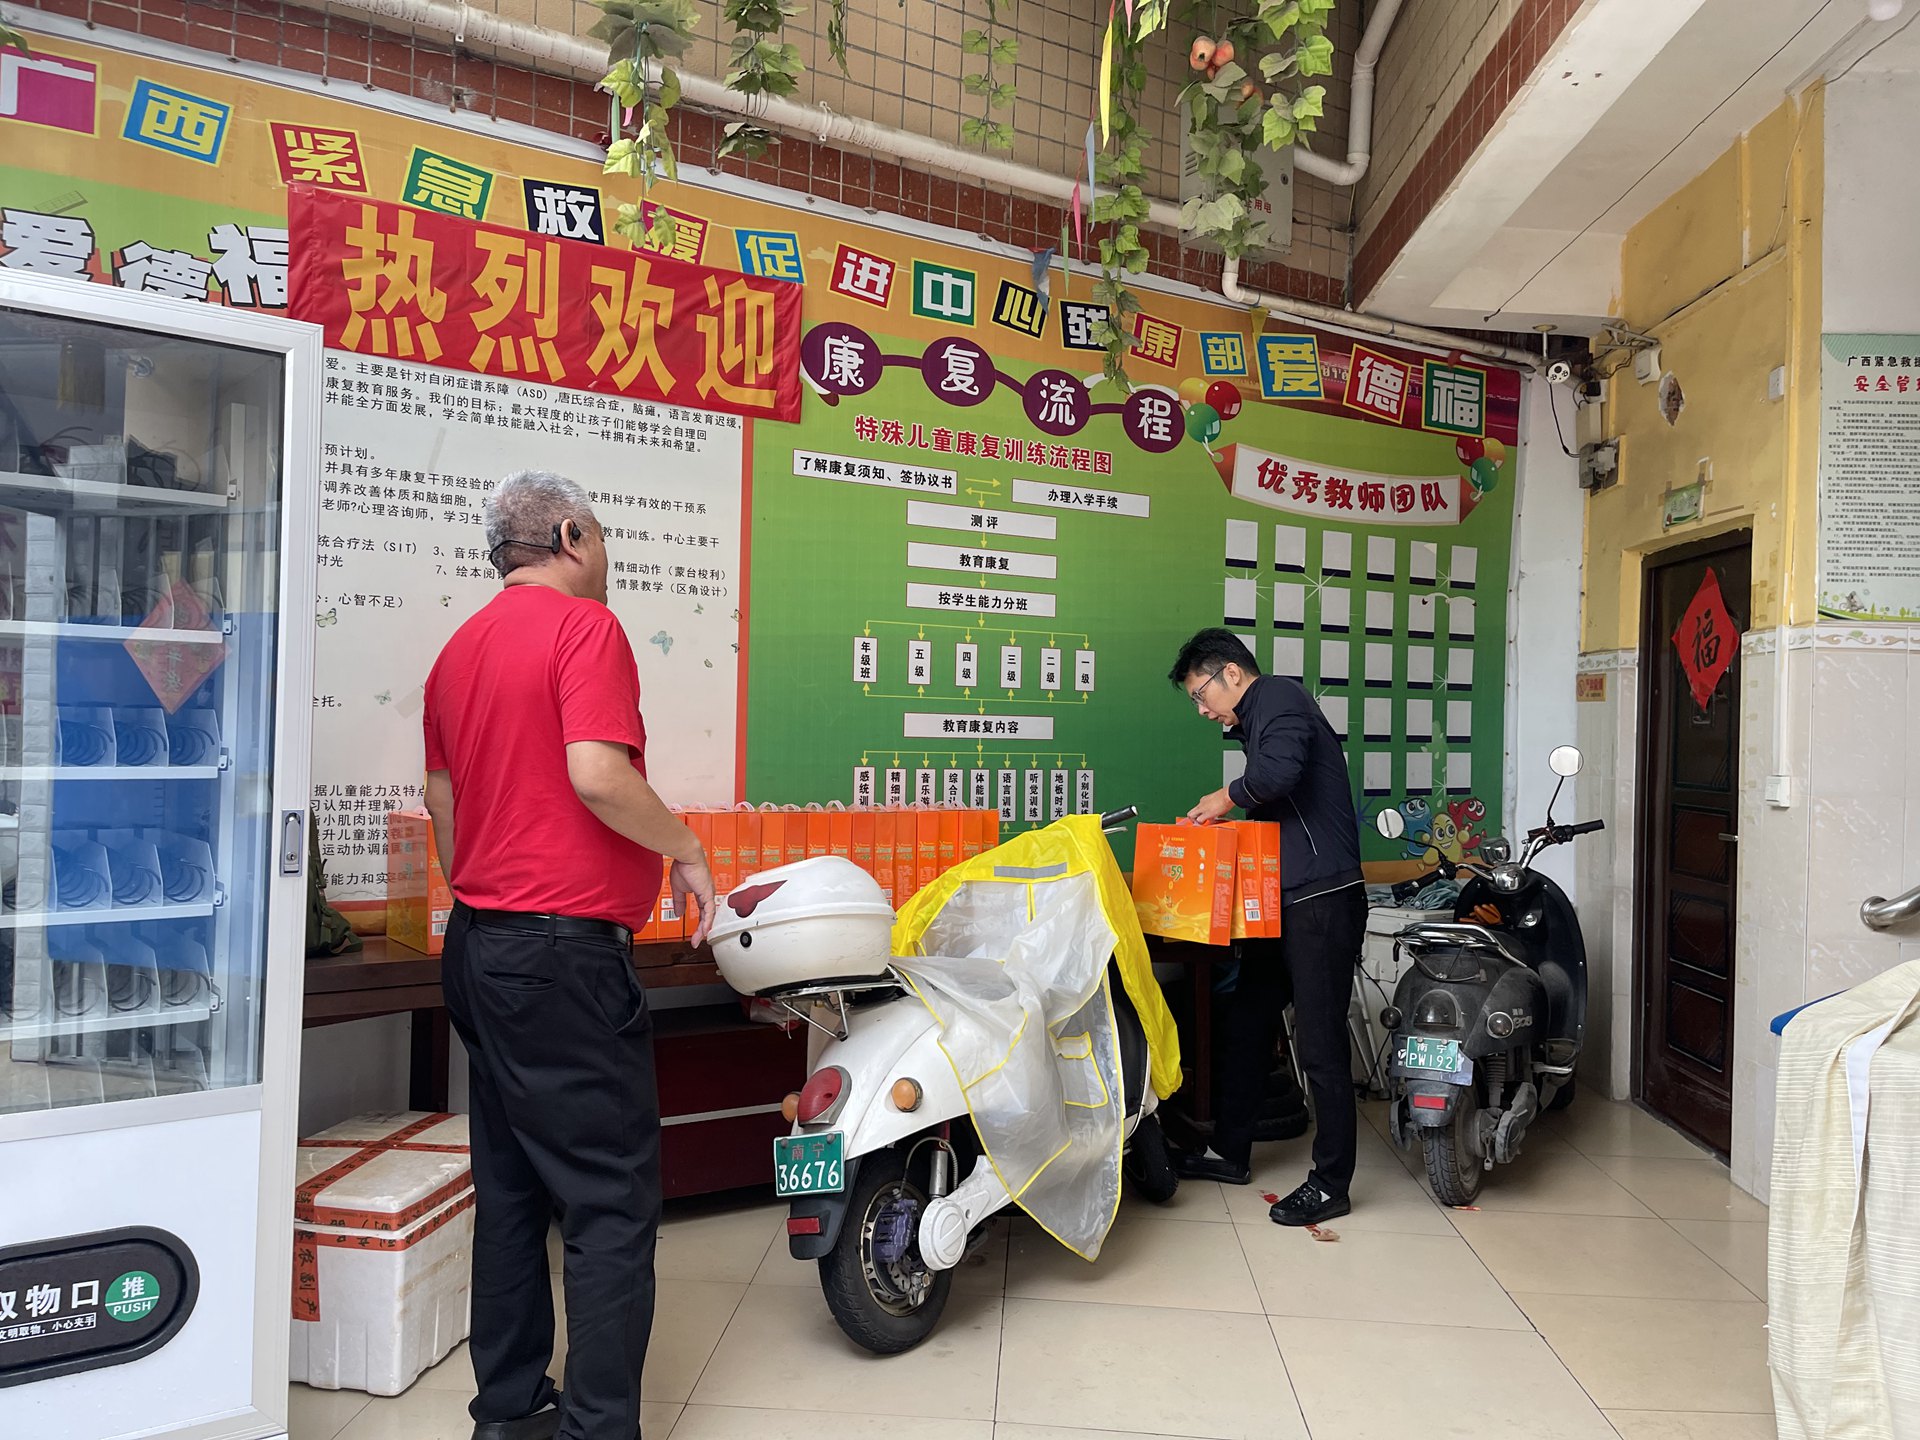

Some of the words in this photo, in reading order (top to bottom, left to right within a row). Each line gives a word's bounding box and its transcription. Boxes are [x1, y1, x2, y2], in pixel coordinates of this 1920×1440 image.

[341, 205, 776, 408] 热烈欢迎
[821, 334, 1172, 442] 康复流程
[1854, 375, 1920, 393] 安全管
[855, 415, 1113, 474] 特殊儿童康复训练流程图
[800, 456, 952, 489] 了解康复须知、签协议书
[1257, 458, 1449, 513] 优秀教师团队
[320, 480, 487, 508] 调养改善体质和脑细胞，
[1048, 489, 1118, 509] 办理入学手续
[971, 515, 998, 529] 测评
[959, 554, 1009, 570] 教育康复
[938, 592, 1028, 611] 按学生能力分班
[1692, 608, 1720, 672] 福
[861, 641, 871, 679] 年级班
[915, 649, 924, 677] 五级
[962, 652, 972, 679] 四级
[1007, 655, 1016, 682] 三级
[1046, 657, 1055, 683] 二级
[1081, 661, 1090, 684] 一级
[943, 719, 1019, 734] 教育康复内容
[975, 773, 984, 809] 体能训
[1002, 773, 1011, 818] 语言训练
[1030, 773, 1038, 817] 听觉训练
[1055, 773, 1063, 817] 地板时光
[316, 829, 388, 841] 升儿童游
[1409, 1053, 1453, 1069] PW192
[1417, 1043, 1447, 1053] 南宁
[792, 1142, 825, 1160] 南宁
[779, 1160, 840, 1191] 36676
[122, 1276, 145, 1299] 推
[113, 1301, 151, 1315] PUSH
